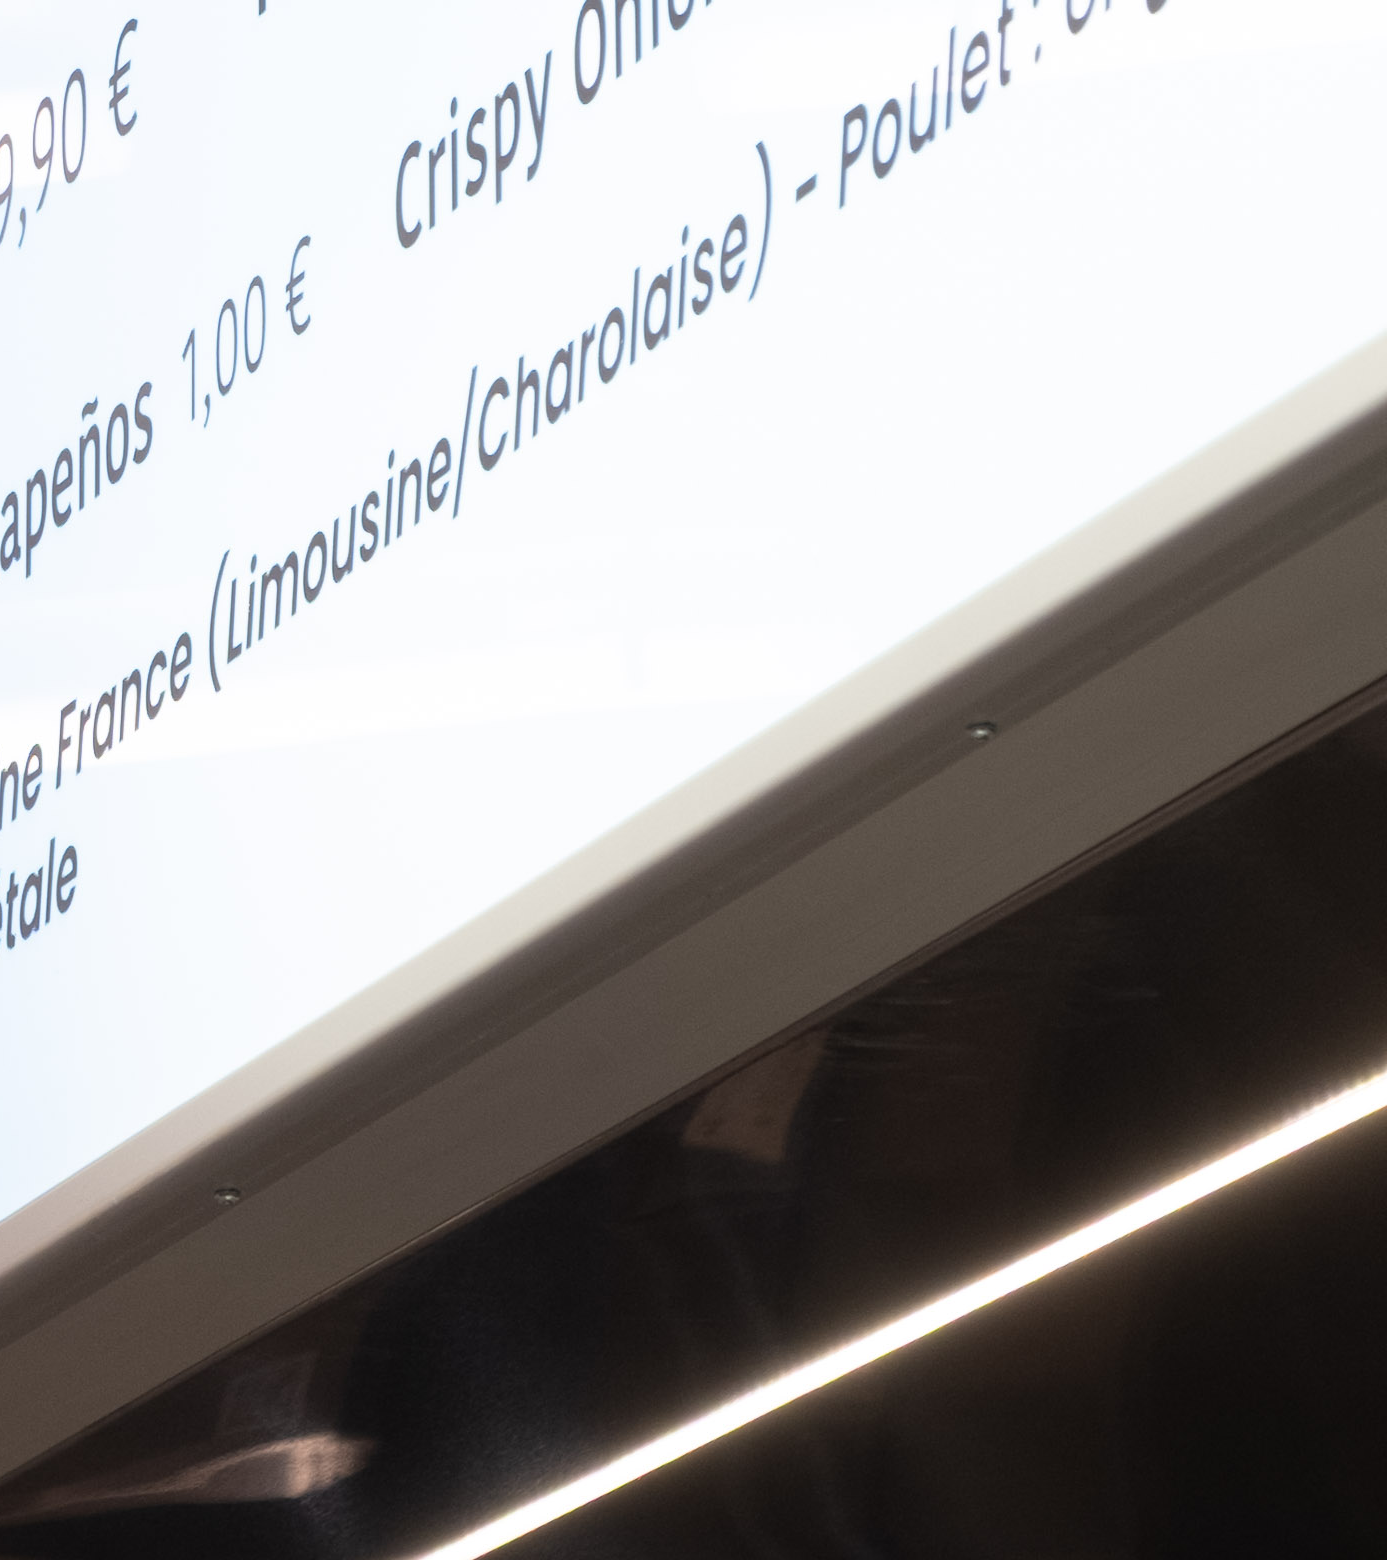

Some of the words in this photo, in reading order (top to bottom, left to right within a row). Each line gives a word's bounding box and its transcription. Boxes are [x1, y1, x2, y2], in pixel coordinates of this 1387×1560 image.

[107, 17, 139, 137] €
[181, 274, 267, 430] 1,00
[284, 234, 312, 337] €
[394, 48, 554, 251] Crispy
[54, 631, 194, 791] France
[207, 139, 774, 694] (Limousine/Charolaise)
